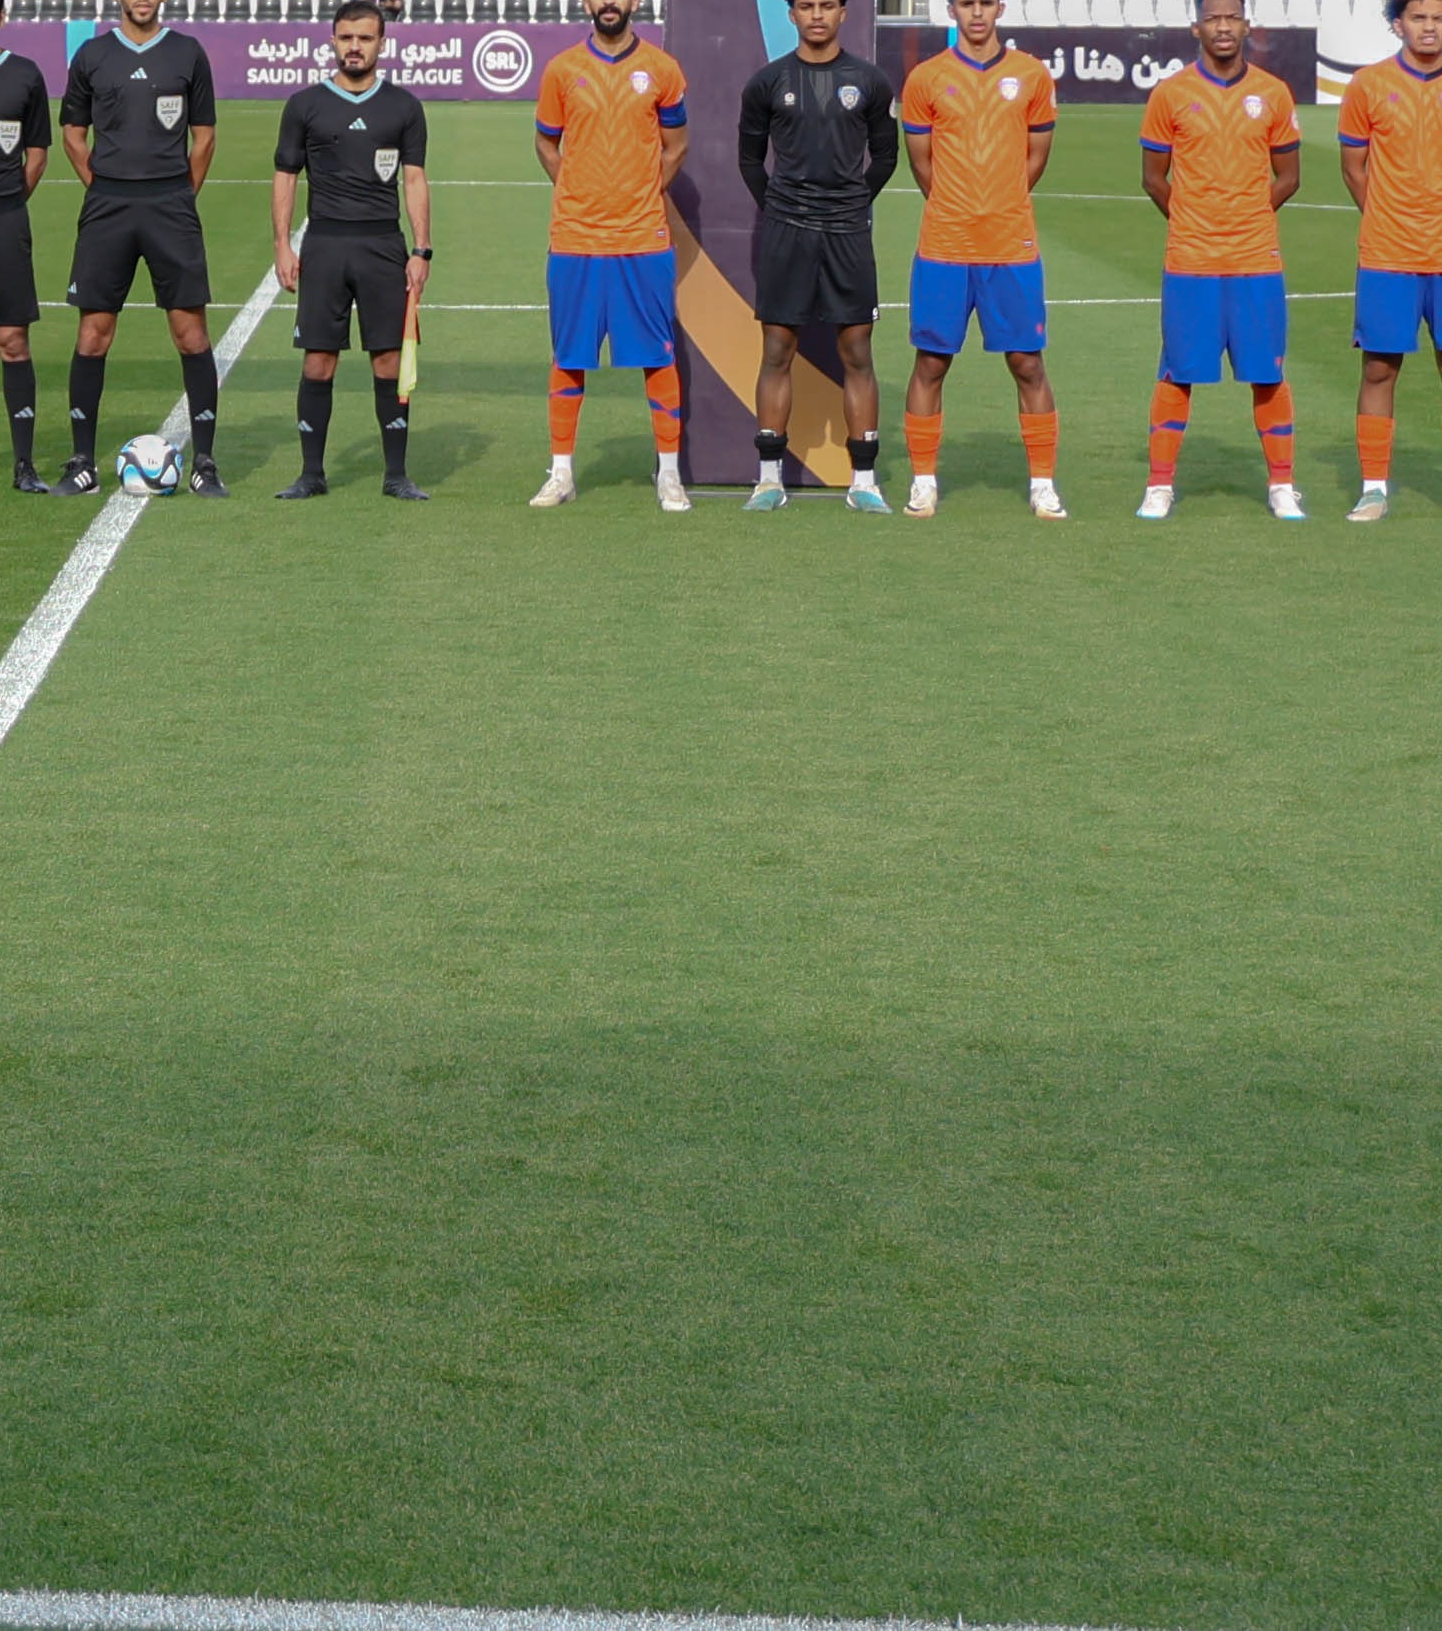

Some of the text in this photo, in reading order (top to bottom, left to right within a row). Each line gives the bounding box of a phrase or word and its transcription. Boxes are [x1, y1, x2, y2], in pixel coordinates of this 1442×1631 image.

[248, 37, 309, 65] الرديف
[401, 38, 462, 67] الدوري
[485, 51, 519, 70] SRL
[1074, 46, 1125, 81] هنا
[246, 68, 302, 85] SAUDI
[392, 68, 463, 85] LEAGUE
